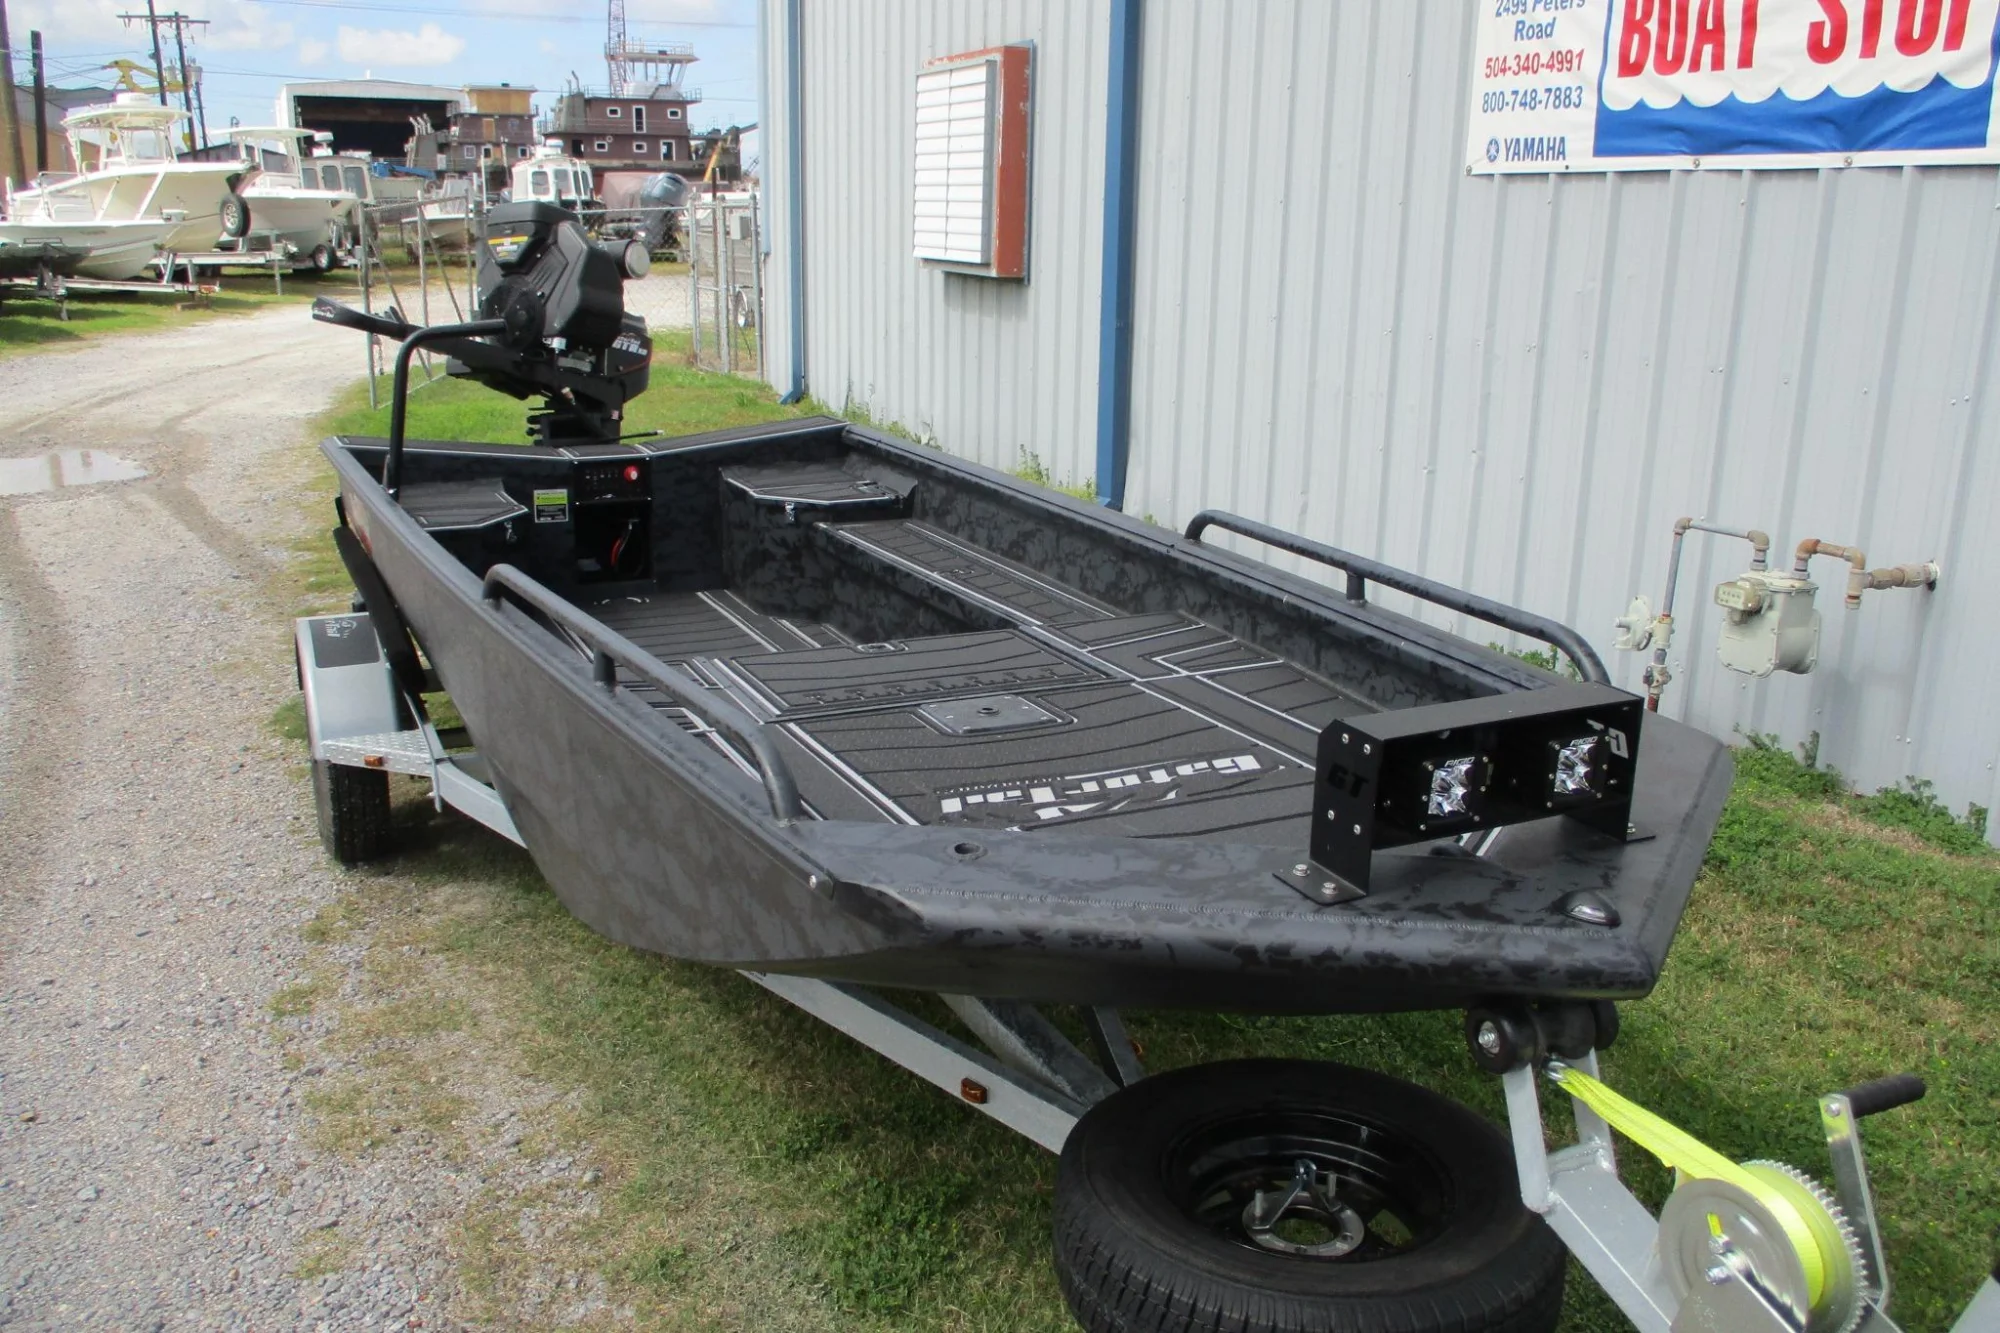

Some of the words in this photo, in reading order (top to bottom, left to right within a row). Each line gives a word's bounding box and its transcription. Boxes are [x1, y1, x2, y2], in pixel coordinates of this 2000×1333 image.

[1495, 0, 1527, 17] 2499
[1531, 0, 1586, 13] Peters
[1514, 17, 1557, 41] Road
[1484, 48, 1585, 79] 504-340-4991
[1482, 85, 1583, 113] 800-748-7883
[1504, 136, 1567, 161] YAMAHA
